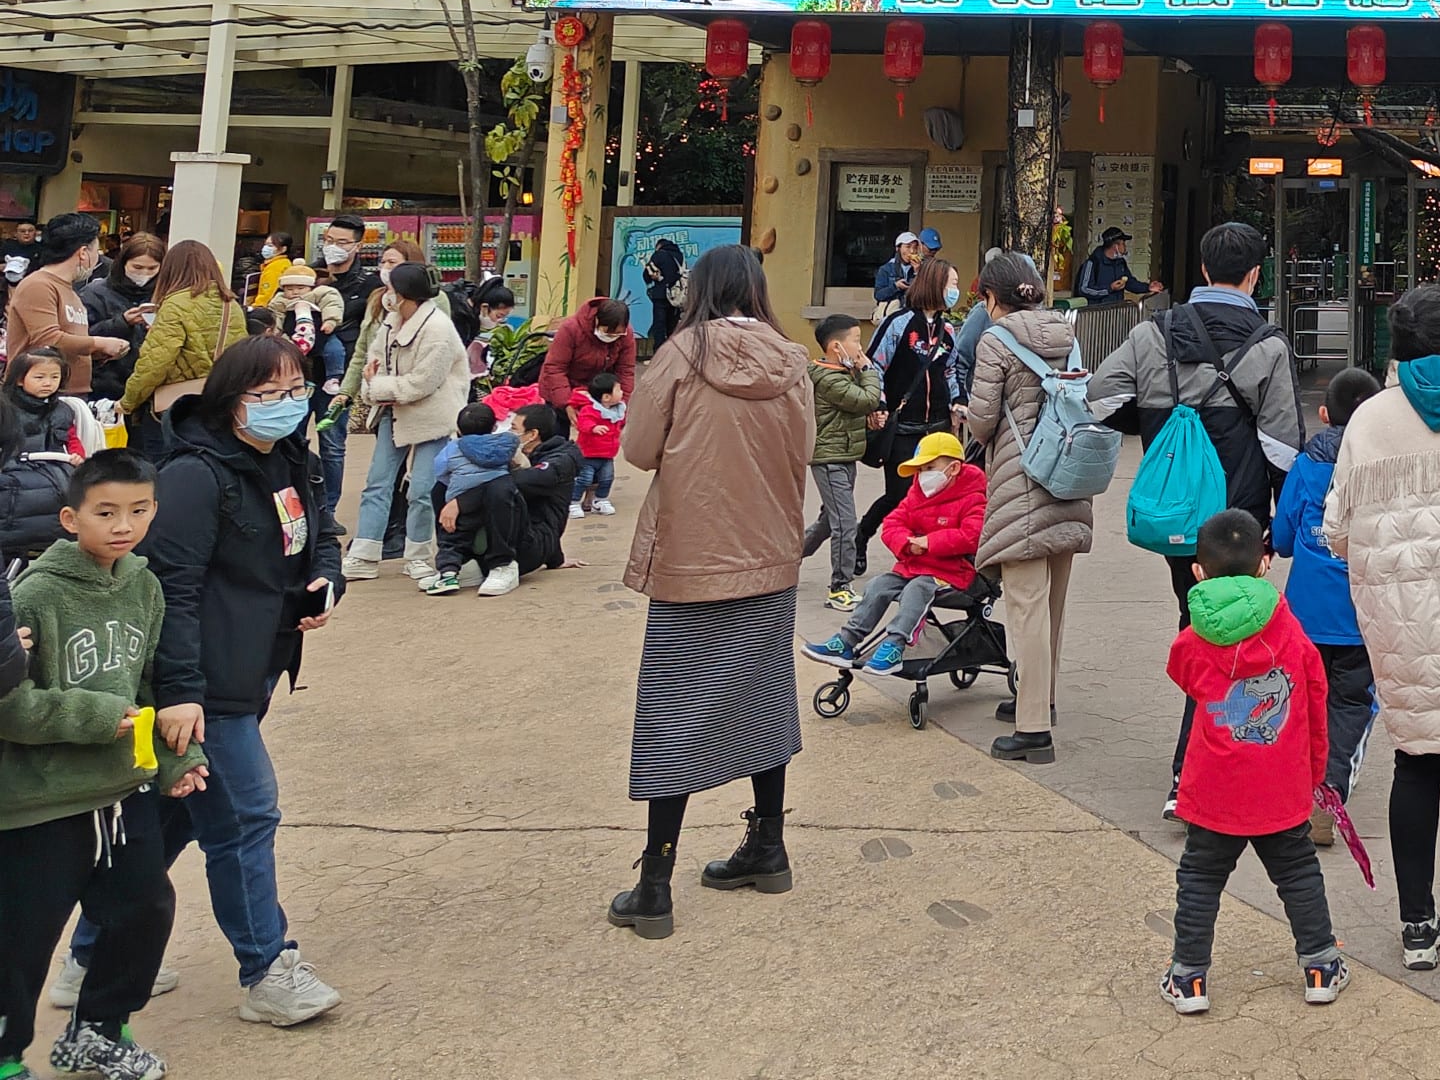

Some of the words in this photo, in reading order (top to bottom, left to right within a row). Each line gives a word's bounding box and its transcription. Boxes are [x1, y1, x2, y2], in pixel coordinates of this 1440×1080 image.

[845, 173, 903, 186] 贮存服务处
